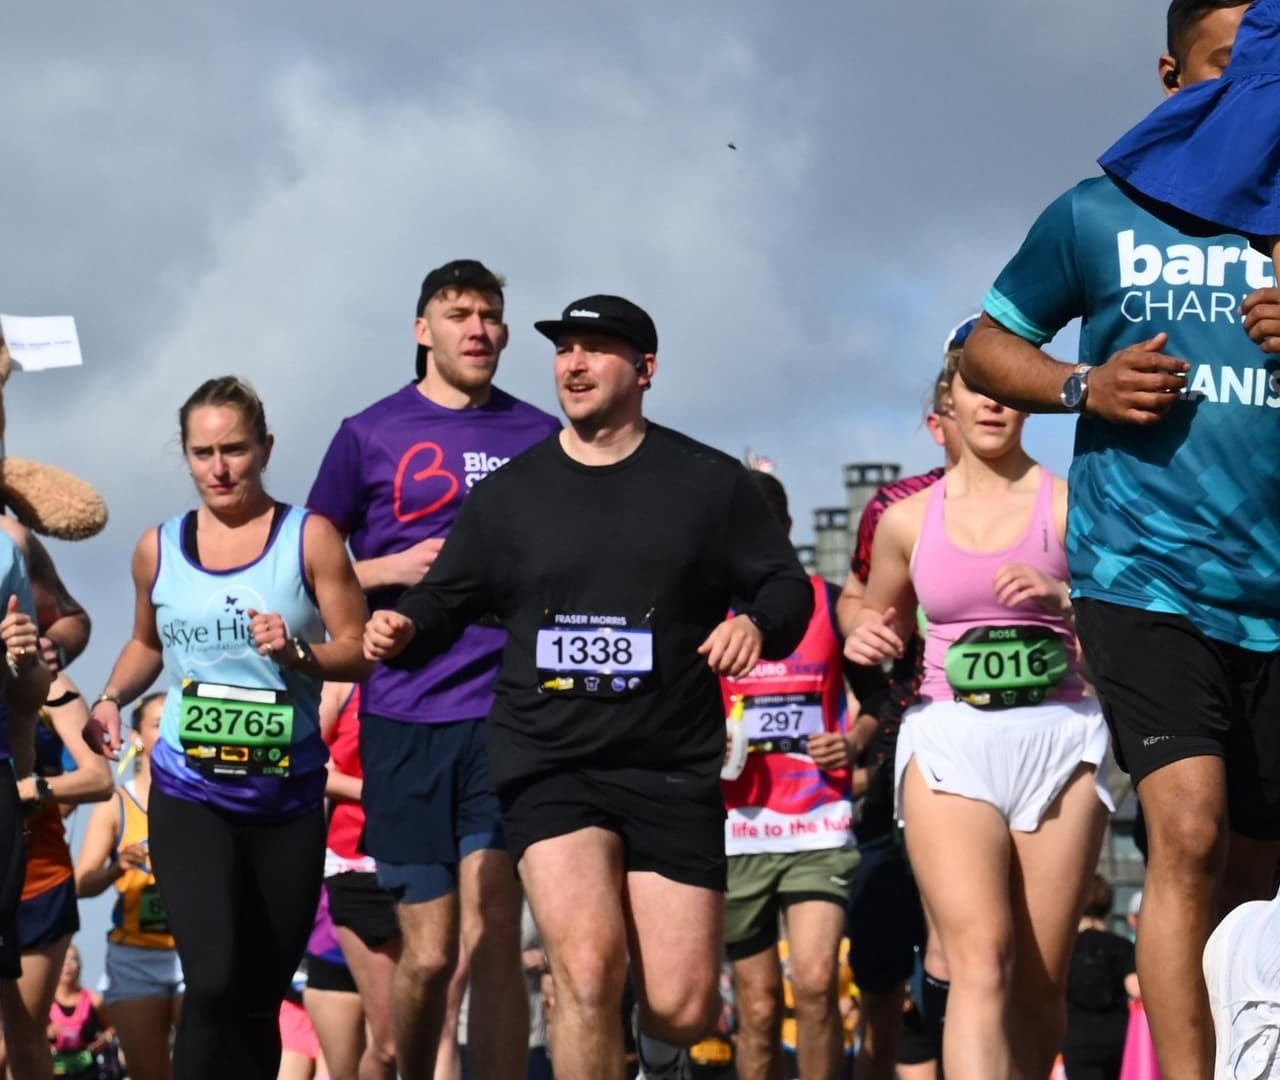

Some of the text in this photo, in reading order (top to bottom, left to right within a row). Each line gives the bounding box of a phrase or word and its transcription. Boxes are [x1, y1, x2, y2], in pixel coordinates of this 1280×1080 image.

[1117, 229, 1279, 289] bart
[554, 614, 627, 626] FRASER MORRIS
[988, 628, 1017, 640] ROSE
[162, 622, 209, 653] Skye
[551, 635, 633, 665] 1338
[961, 647, 1049, 680] 7016
[184, 705, 285, 738] 23765
[759, 709, 804, 733] 297
[731, 820, 759, 839] life
[764, 822, 783, 837] to
[790, 820, 818, 836] the
